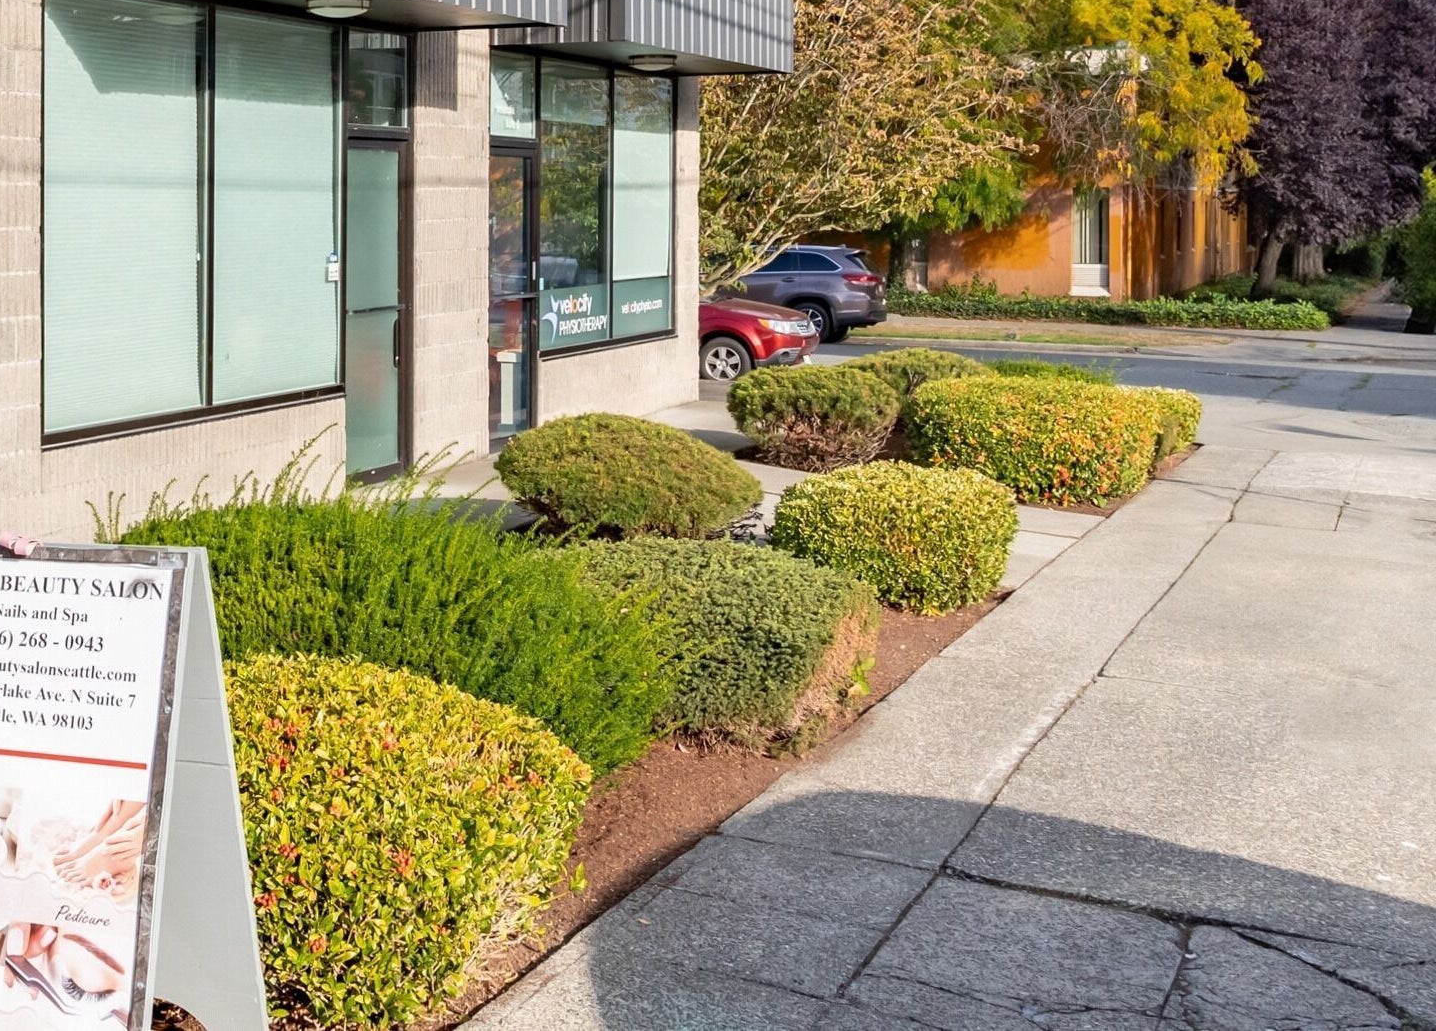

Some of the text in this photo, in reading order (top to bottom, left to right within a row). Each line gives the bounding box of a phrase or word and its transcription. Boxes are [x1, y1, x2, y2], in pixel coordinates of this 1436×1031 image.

[559, 292, 593, 316] velocity
[559, 314, 607, 336] PHYSIOTHERAPY
[0, 573, 86, 596] BEAUTY
[90, 578, 164, 601] SALON
[31, 605, 58, 621] and
[62, 608, 88, 625] Spa
[18, 630, 48, 649] 268
[64, 633, 105, 653] 0943
[34, 685, 66, 702] Ave.
[69, 687, 82, 704] N
[86, 689, 124, 708] Suite
[127, 693, 137, 708] 7
[21, 709, 48, 727] WA
[51, 711, 94, 731] 98103
[54, 904, 112, 928] Pedicure
